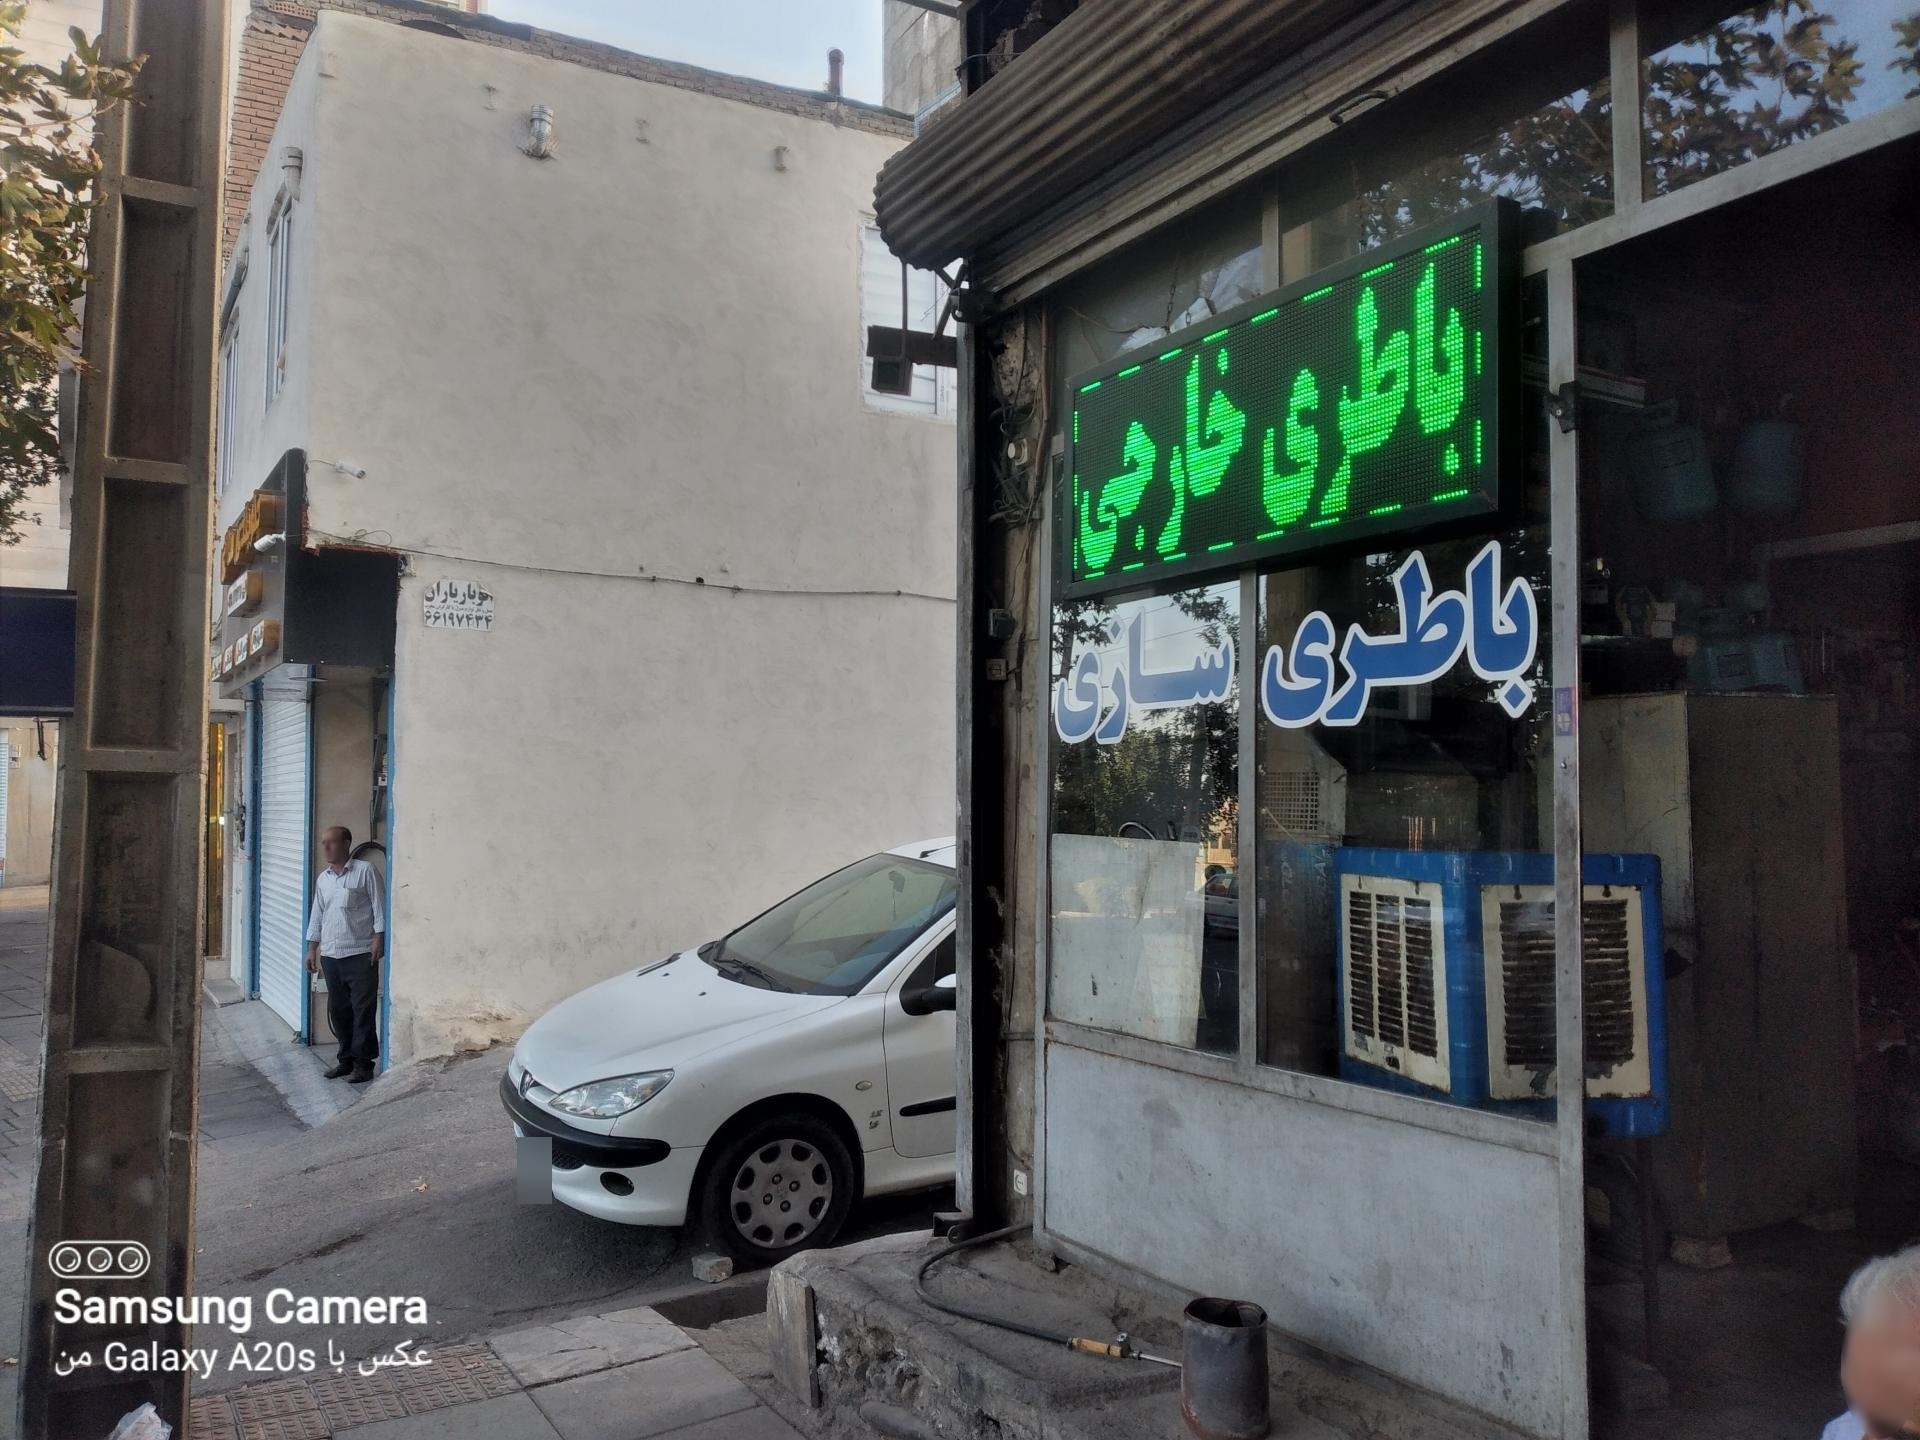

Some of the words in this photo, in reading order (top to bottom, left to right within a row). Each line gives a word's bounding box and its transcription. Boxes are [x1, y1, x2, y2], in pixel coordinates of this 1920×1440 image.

[1080, 348, 1246, 568] خارجی
[1262, 262, 1465, 526] باطری
[1055, 606, 1235, 745] سازی
[1261, 540, 1539, 730] باطری
